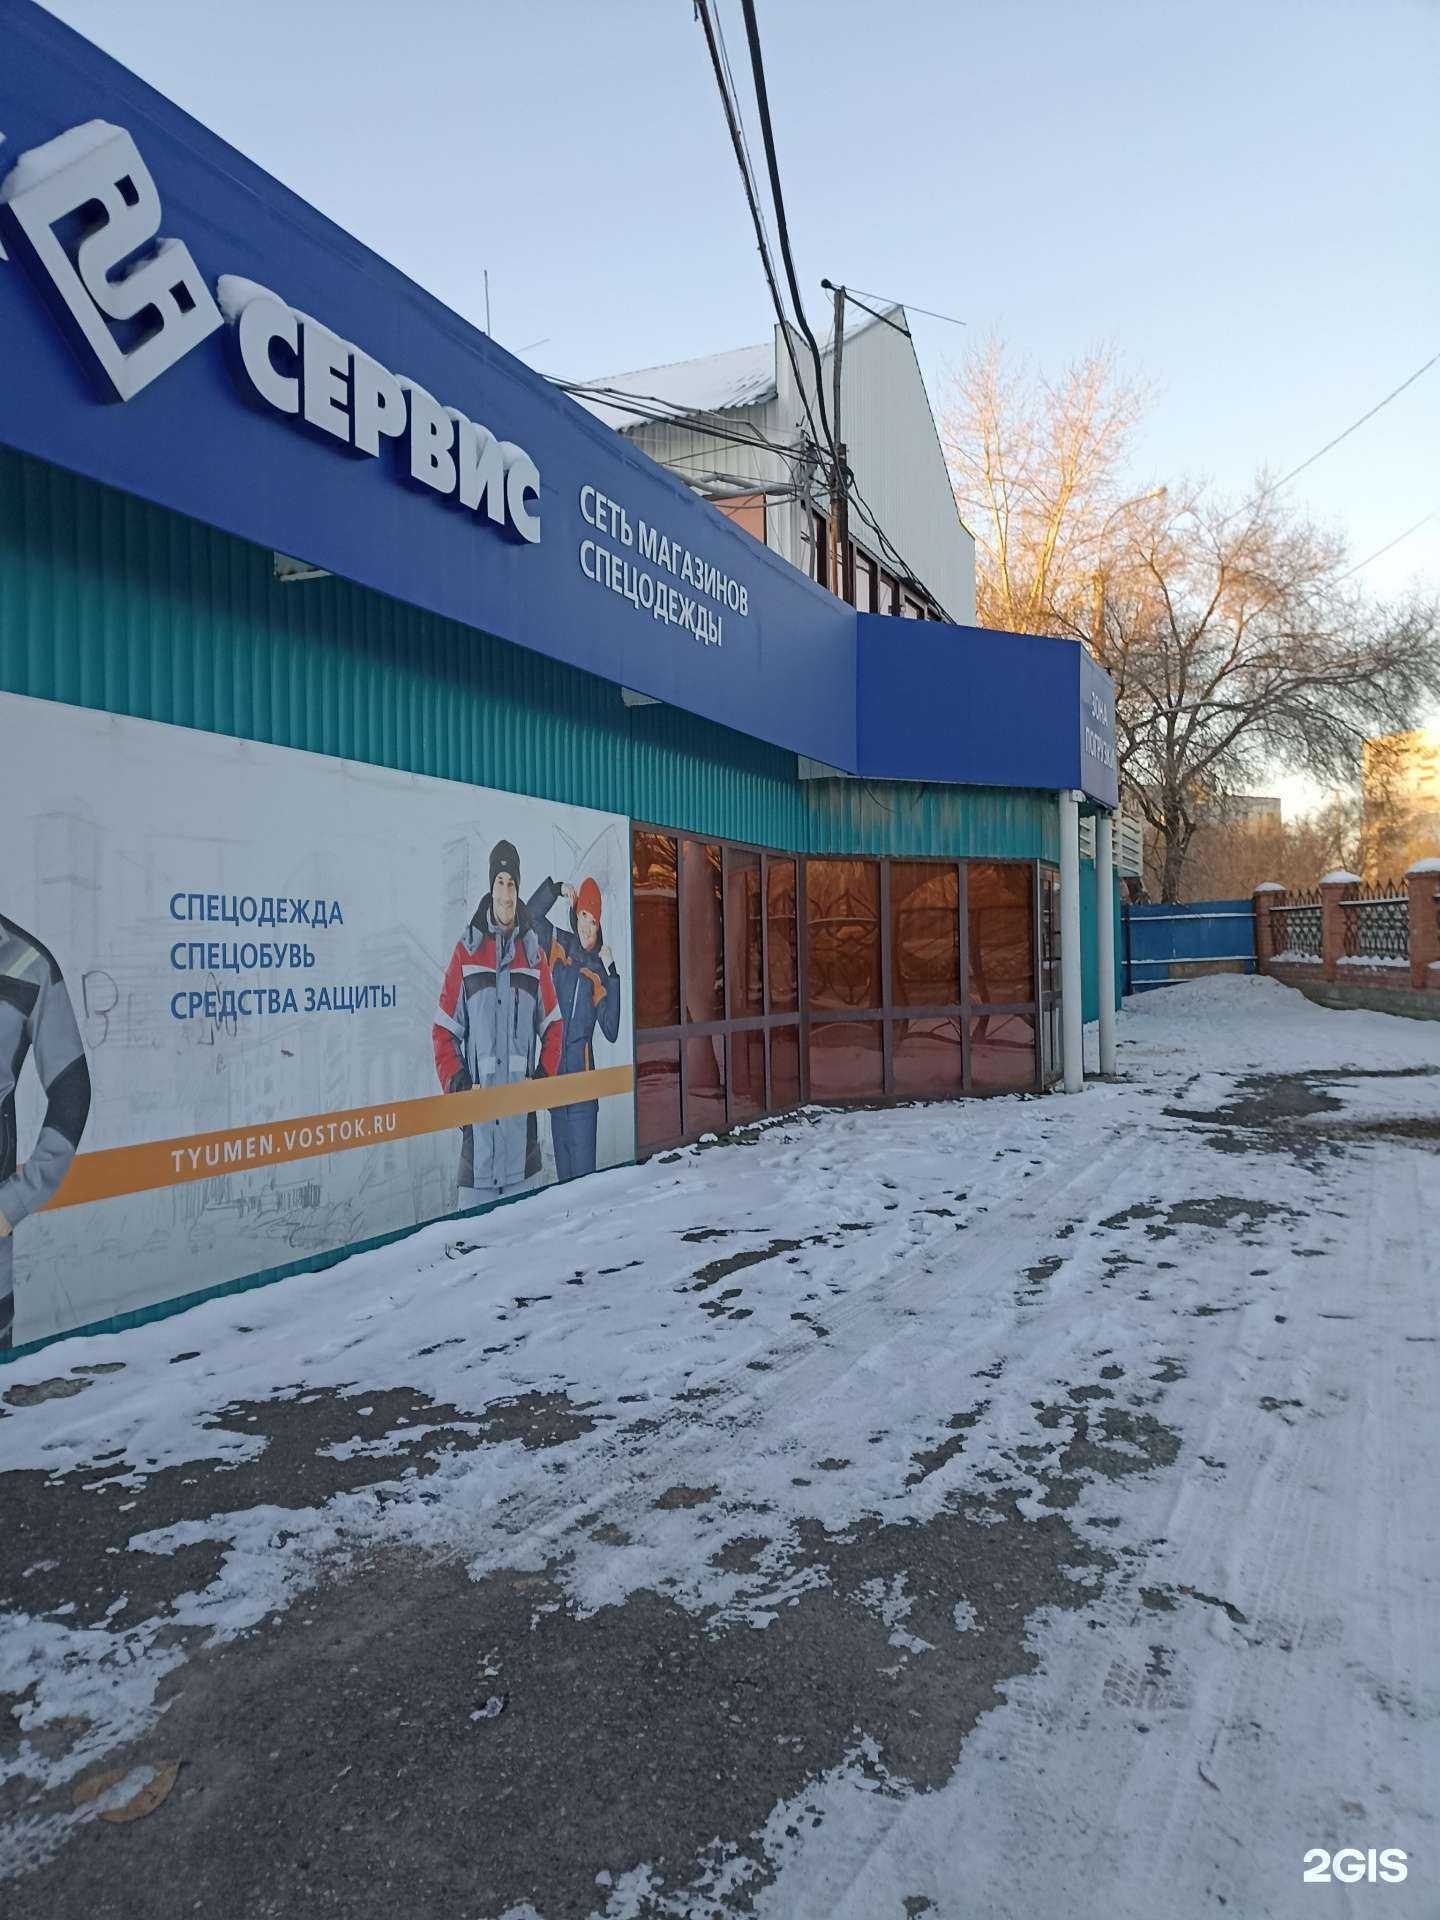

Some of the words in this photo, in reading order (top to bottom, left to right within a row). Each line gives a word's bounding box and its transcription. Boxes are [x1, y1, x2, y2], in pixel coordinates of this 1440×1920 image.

[237, 292, 541, 544] СЕРВИС
[579, 484, 634, 546] СЕТЬ
[638, 519, 749, 617] МАГАЗИНОВ
[579, 539, 723, 647] СПЕЦОДЕЖДЫ
[169, 892, 344, 929] СПЕЦОДЕЖДА
[170, 942, 316, 973] СПЕЦОБУВЬ
[170, 988, 299, 1022] СРЕДСТВА
[304, 984, 397, 1014] ЗАЩИТЫ
[171, 1112, 397, 1173] TYUMEN.VOSTOK.RU
